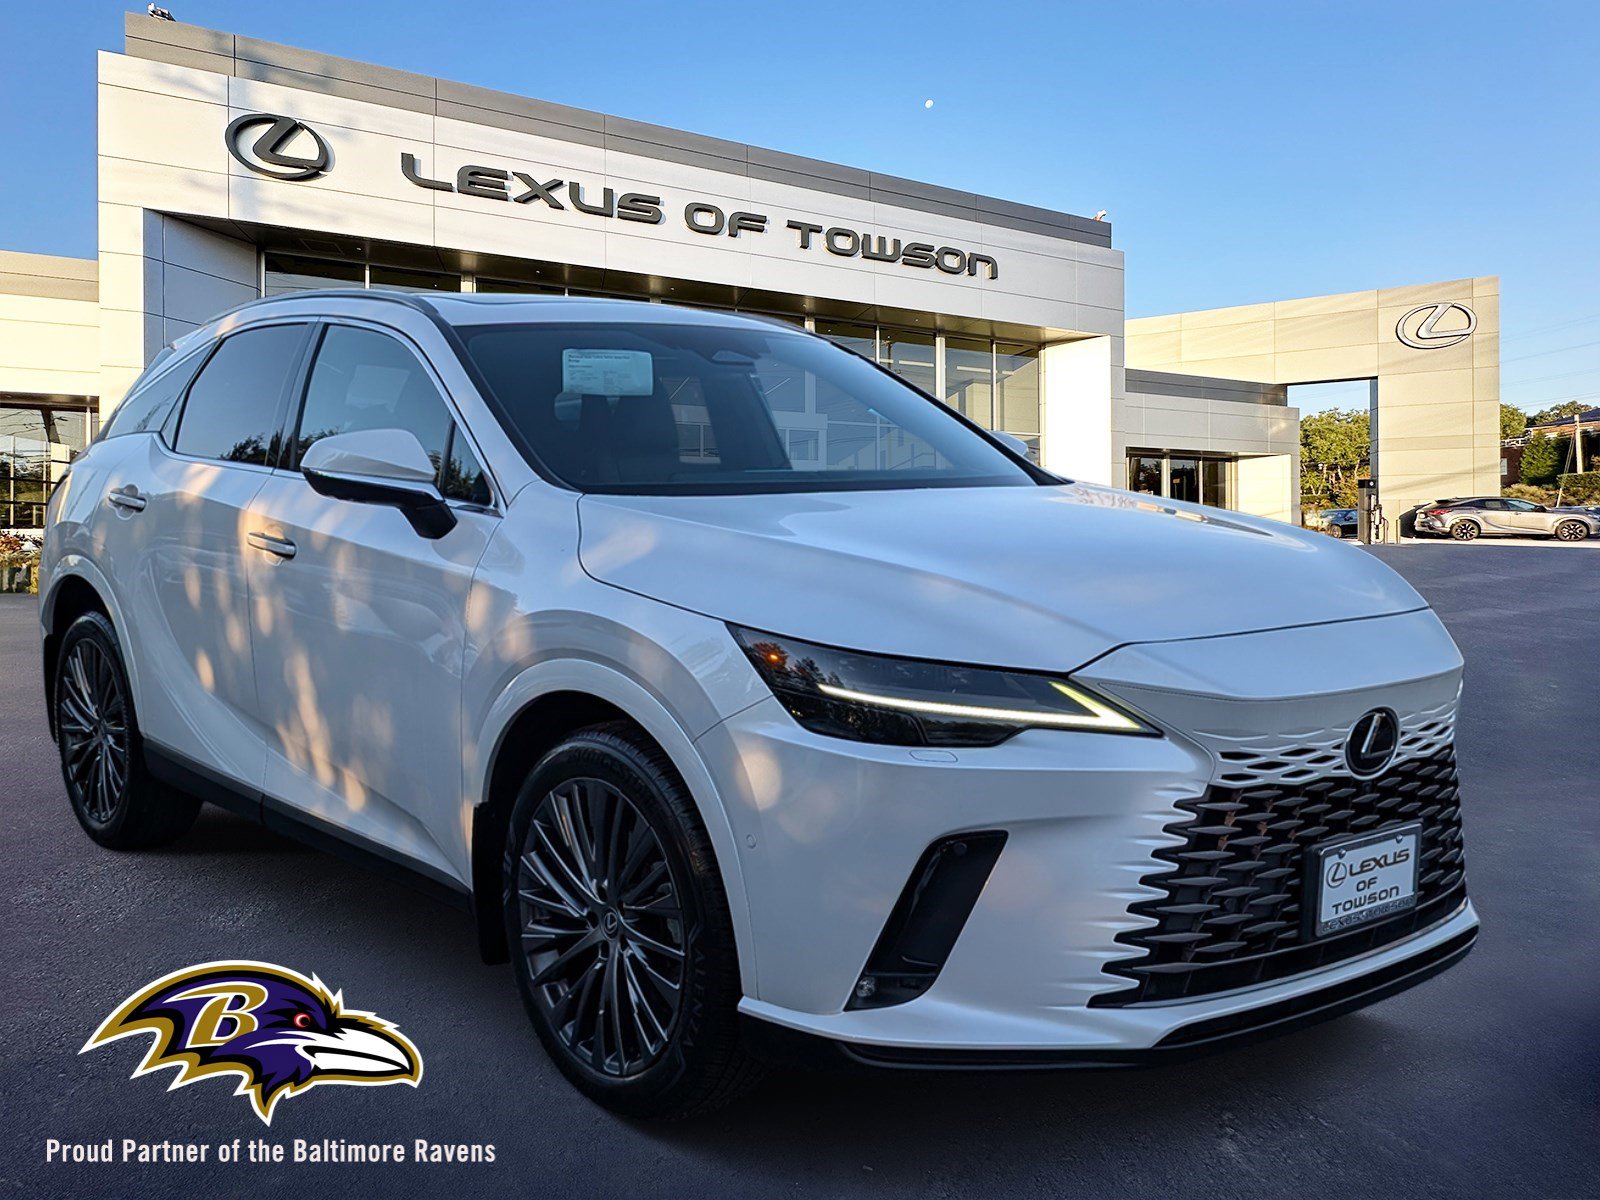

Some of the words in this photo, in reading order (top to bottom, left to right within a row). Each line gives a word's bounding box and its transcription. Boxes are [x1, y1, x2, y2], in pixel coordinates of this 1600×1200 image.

[400, 152, 662, 225] LEXUS
[684, 201, 767, 238] OF
[787, 219, 998, 281] TOWSON
[1349, 848, 1410, 877] LEXUS
[1356, 876, 1378, 893] OF
[1332, 885, 1400, 915] TOWSON
